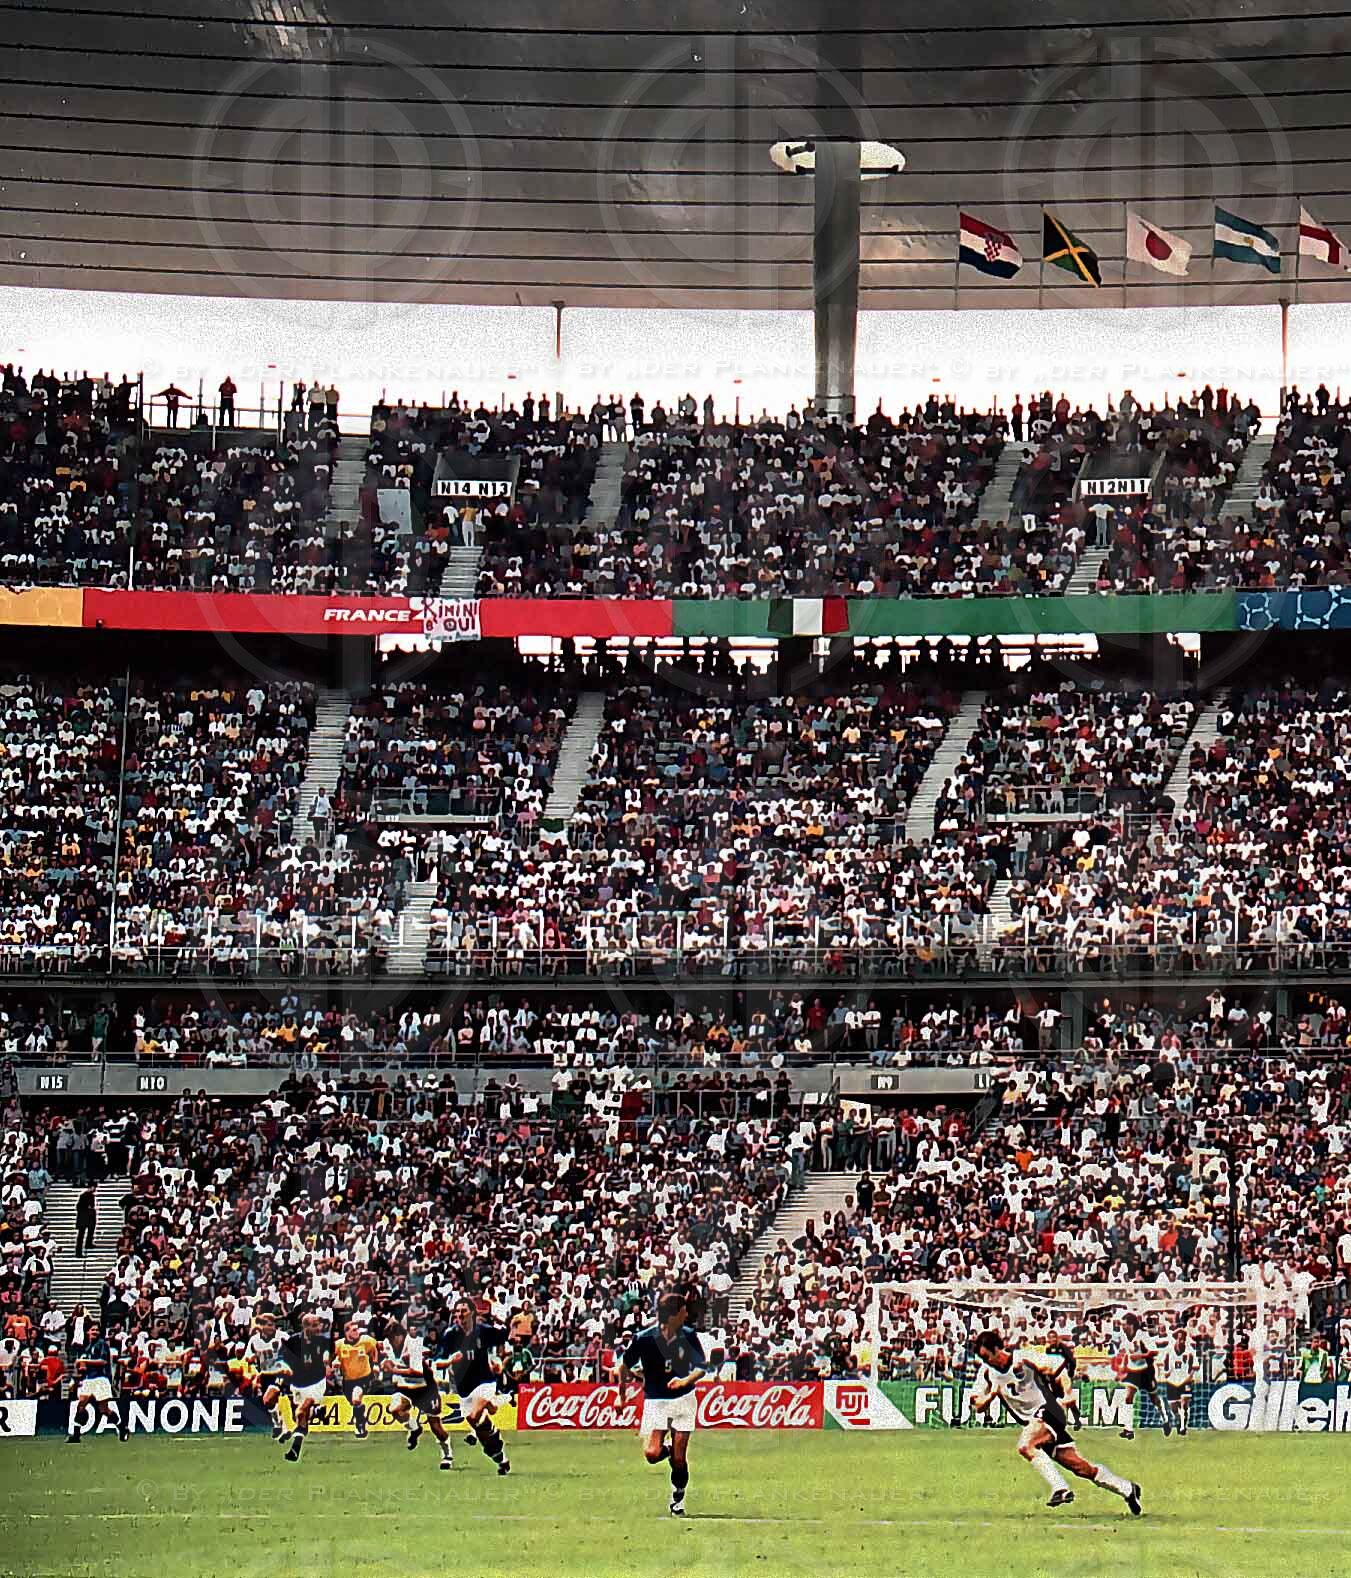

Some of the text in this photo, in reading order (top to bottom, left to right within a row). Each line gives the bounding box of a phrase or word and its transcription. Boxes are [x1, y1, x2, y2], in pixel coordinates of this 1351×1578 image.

[441, 481, 508, 496] N14 N13
[323, 608, 411, 622] FRANCE
[40, 1075, 63, 1089] N15
[140, 1076, 165, 1090] N10
[698, 1385, 816, 1427] Coca-Cola
[68, 1399, 245, 1435] DANONE
